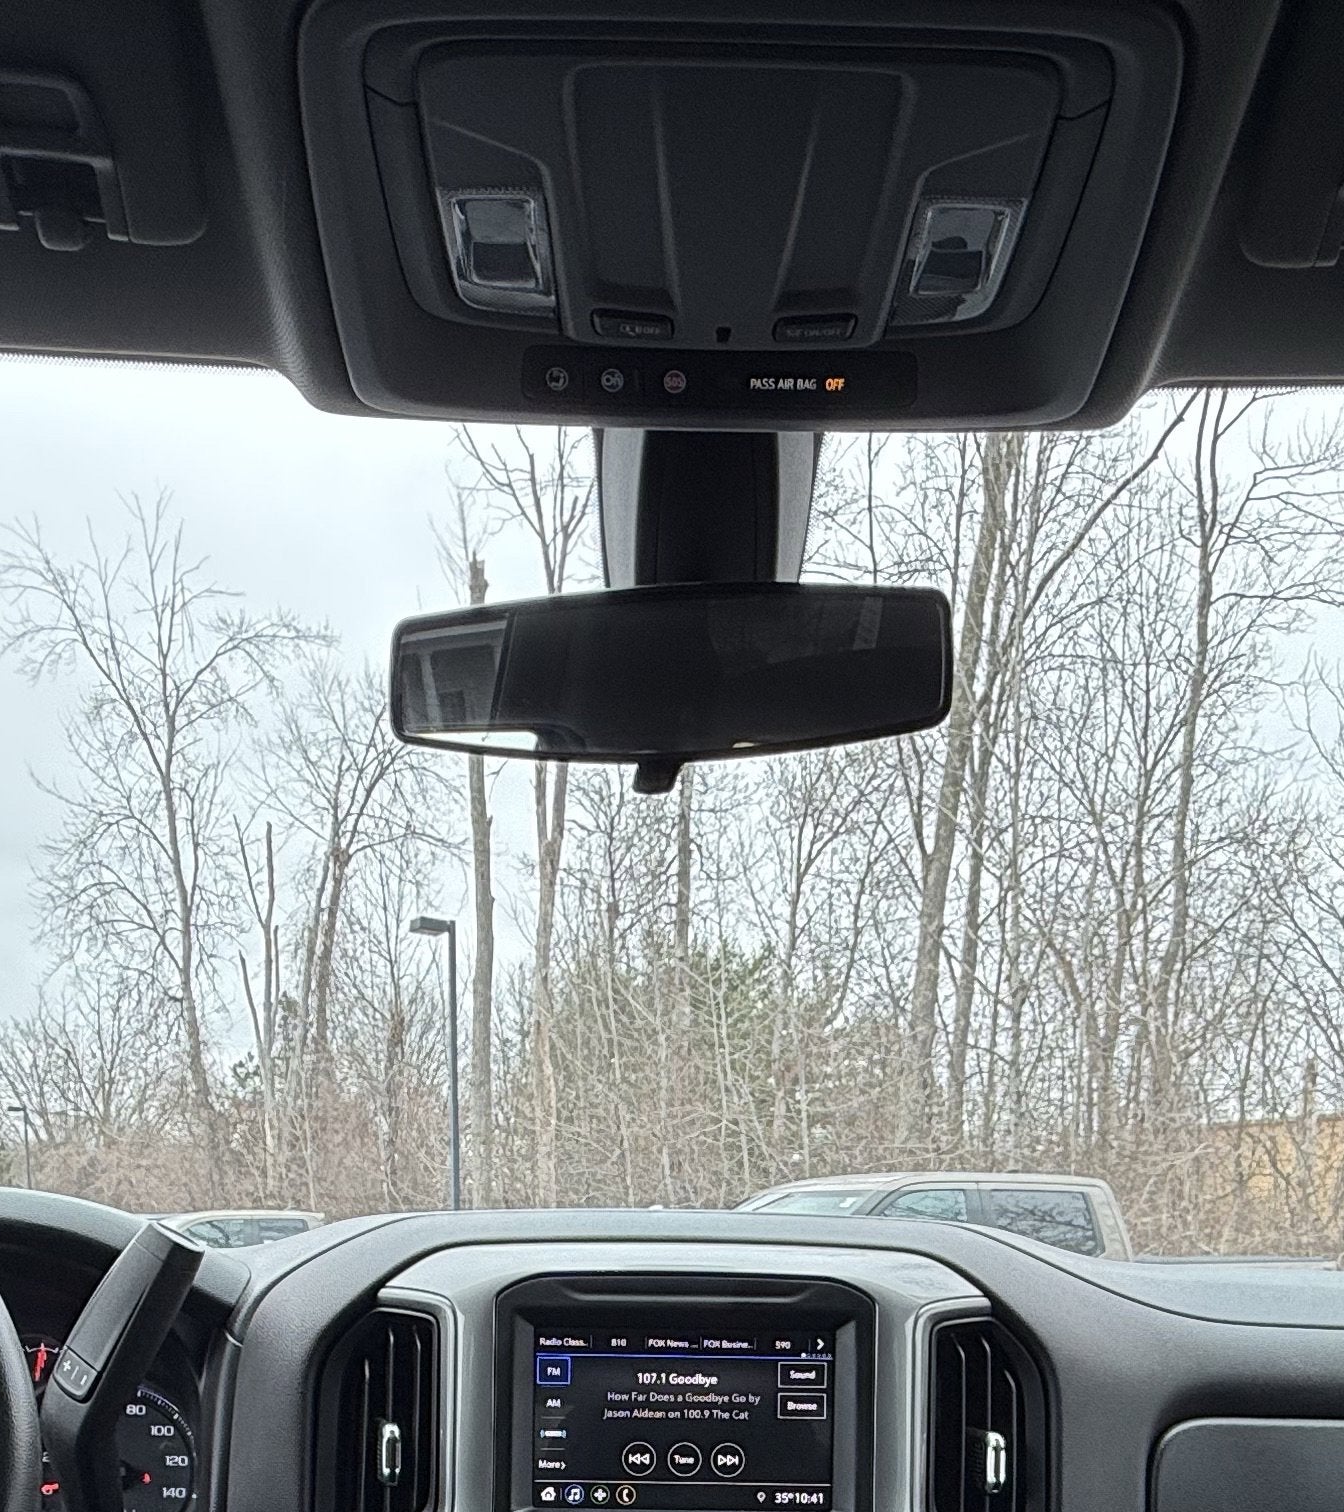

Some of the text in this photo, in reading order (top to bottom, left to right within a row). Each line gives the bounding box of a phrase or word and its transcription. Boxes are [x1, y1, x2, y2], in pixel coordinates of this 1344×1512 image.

[750, 378, 846, 391] PASS AIR BAG OFF
[539, 1337, 562, 1347] Radio
[648, 1339, 665, 1348] FOX
[703, 1340, 721, 1349] FOX
[546, 1366, 561, 1377] FM
[637, 1372, 719, 1388] 107.1 Goodbye
[545, 1399, 561, 1409] AM
[608, 1391, 761, 1405] How Far Does a Goodbye Go by
[125, 1404, 147, 1416] 80
[603, 1408, 749, 1420] Jason Aldean on 100.9 The Cat
[150, 1425, 174, 1436] 100
[165, 1455, 188, 1467] 120
[538, 1459, 561, 1469] More
[162, 1487, 186, 1499] 140
[795, 1492, 824, 1504] 10:41
